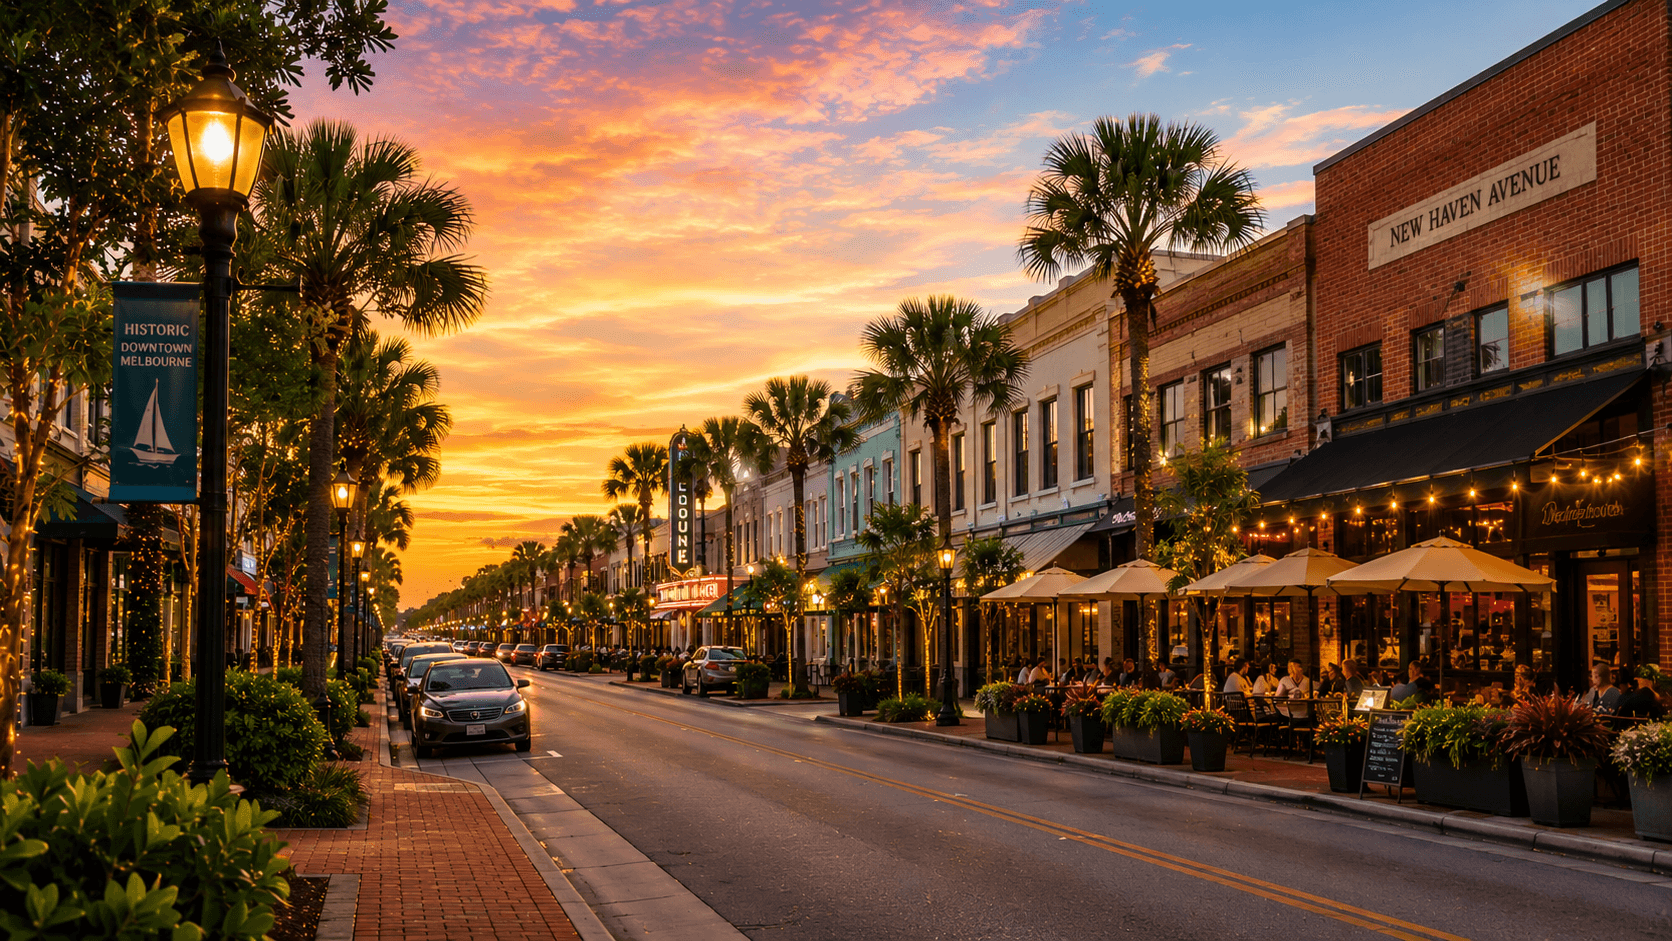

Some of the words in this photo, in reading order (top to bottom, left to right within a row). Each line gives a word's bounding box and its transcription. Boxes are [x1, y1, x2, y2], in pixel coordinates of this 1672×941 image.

[1390, 215, 1423, 247] NEW
[1428, 189, 1482, 231] HAVEN
[1487, 154, 1561, 206] AVENUE
[124, 323, 190, 336] HISTORIC
[121, 342, 192, 353] DOWNTOWN
[120, 355, 192, 367] MELBOURNE
